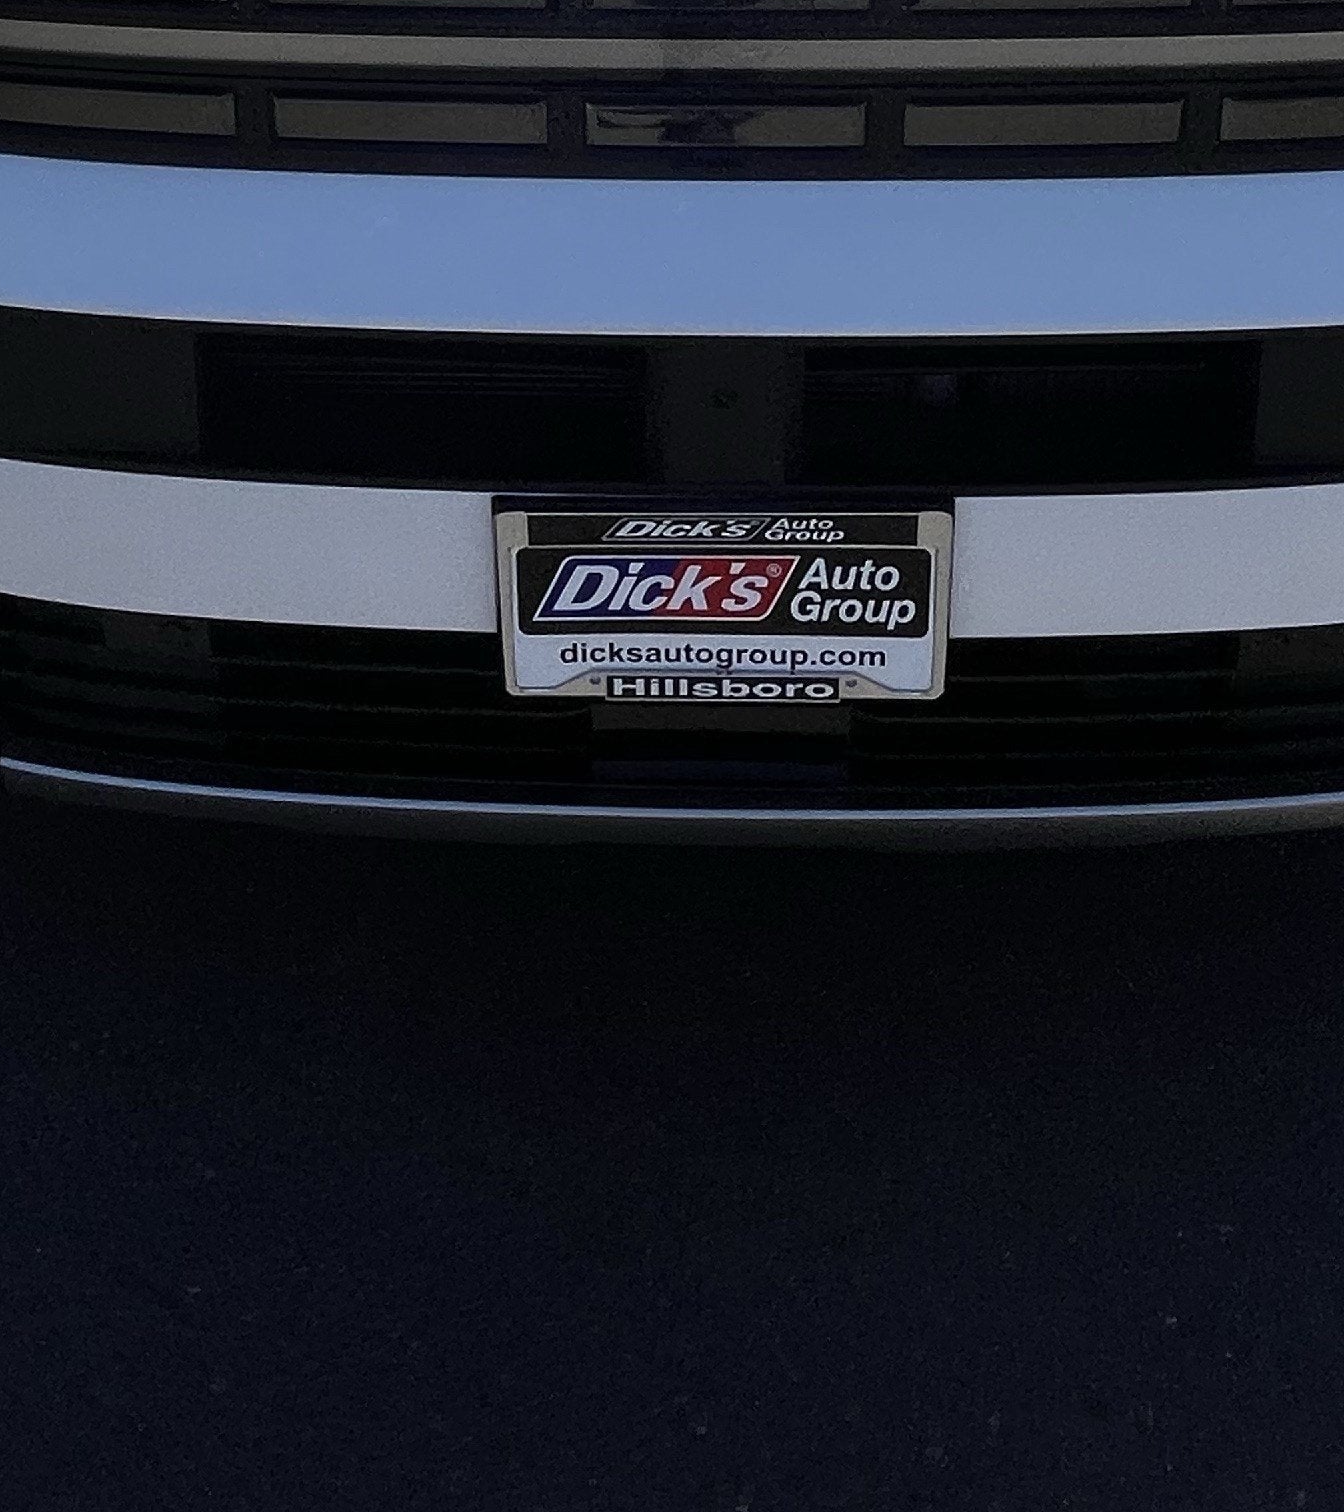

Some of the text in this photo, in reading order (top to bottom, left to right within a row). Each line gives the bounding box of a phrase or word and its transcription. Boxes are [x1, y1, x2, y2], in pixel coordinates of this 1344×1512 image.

[764, 528, 845, 543] Group
[770, 517, 834, 530] Auto
[551, 557, 901, 613] Dick's Auto
[789, 591, 917, 630] Group
[559, 642, 887, 671] dicksautogroup.com
[611, 677, 835, 699] Hillsboro
